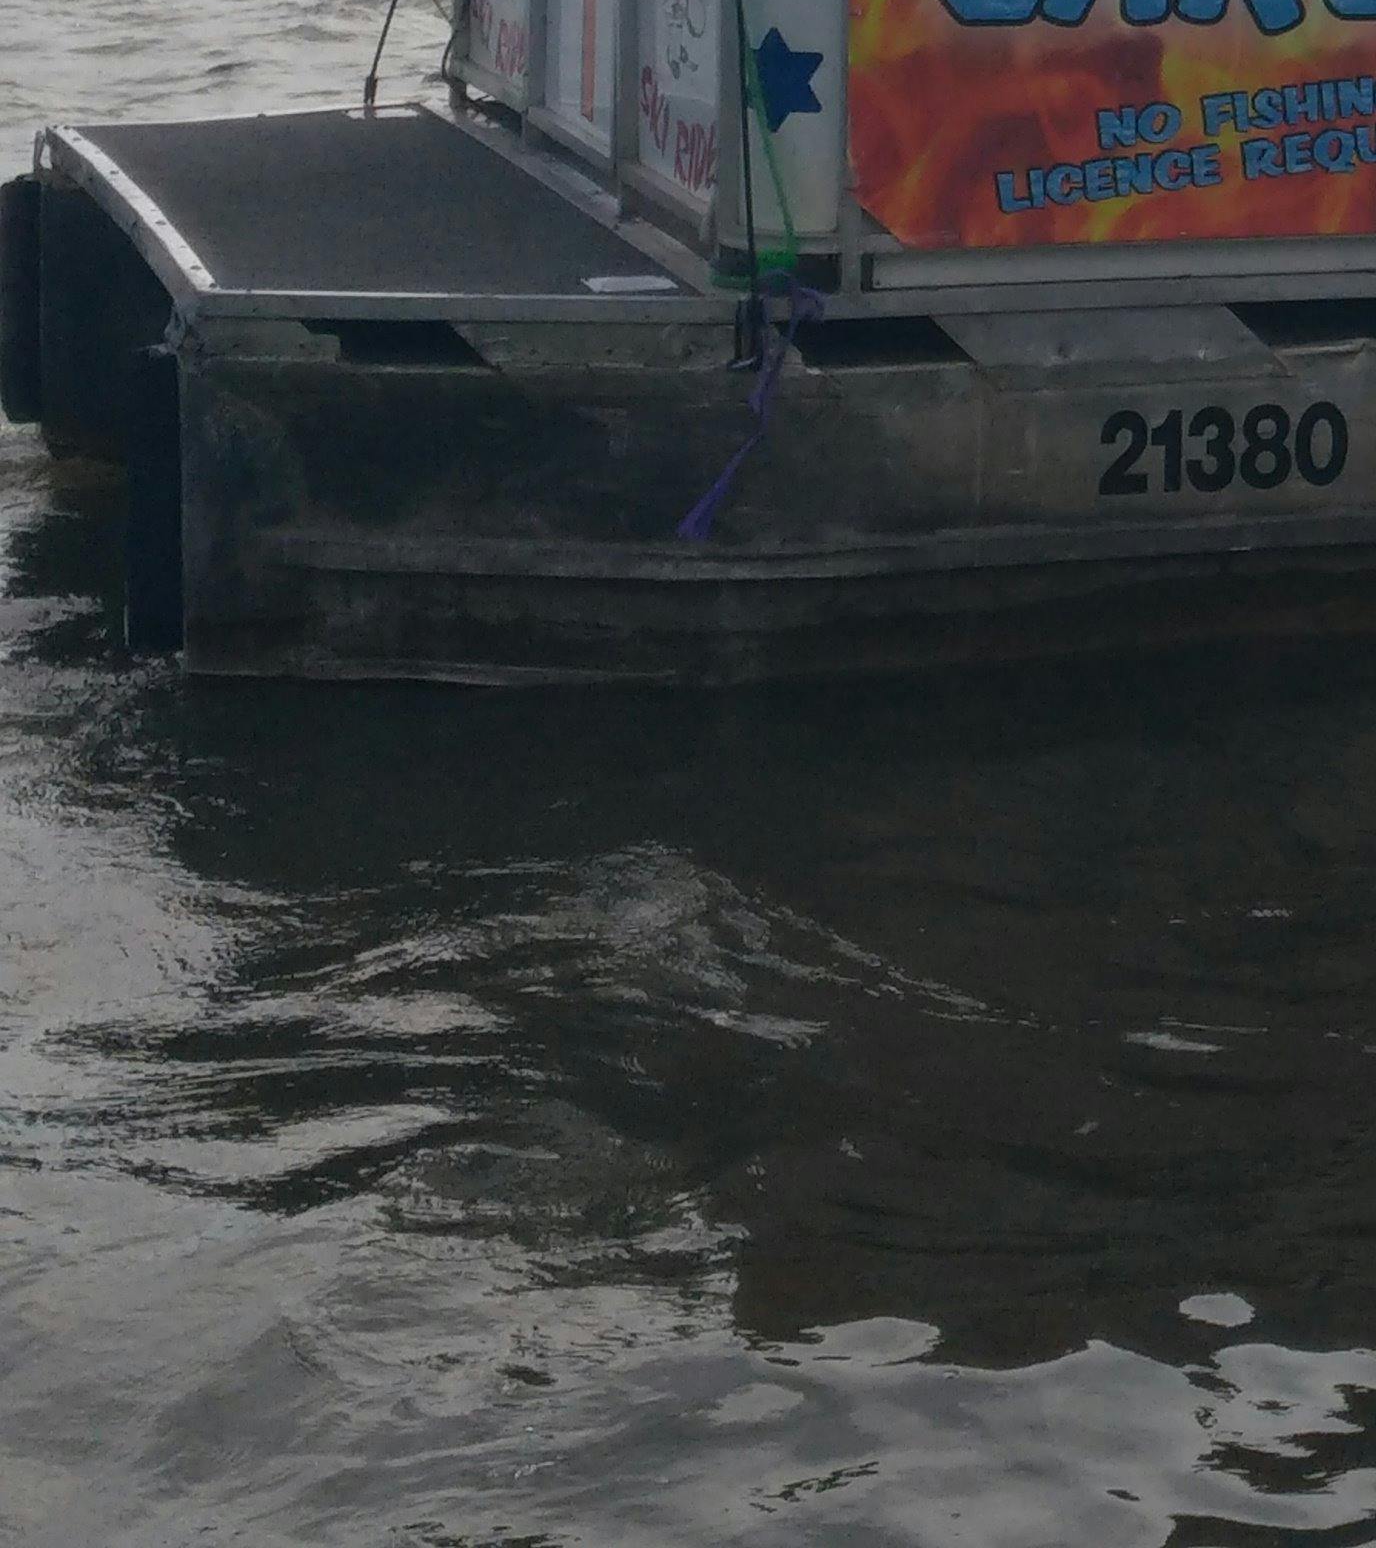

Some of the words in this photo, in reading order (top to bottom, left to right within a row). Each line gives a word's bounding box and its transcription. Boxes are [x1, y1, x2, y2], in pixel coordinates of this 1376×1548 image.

[1096, 103, 1182, 151] NO
[995, 145, 1222, 213] LICENCE
[1099, 401, 1349, 495] 21380
